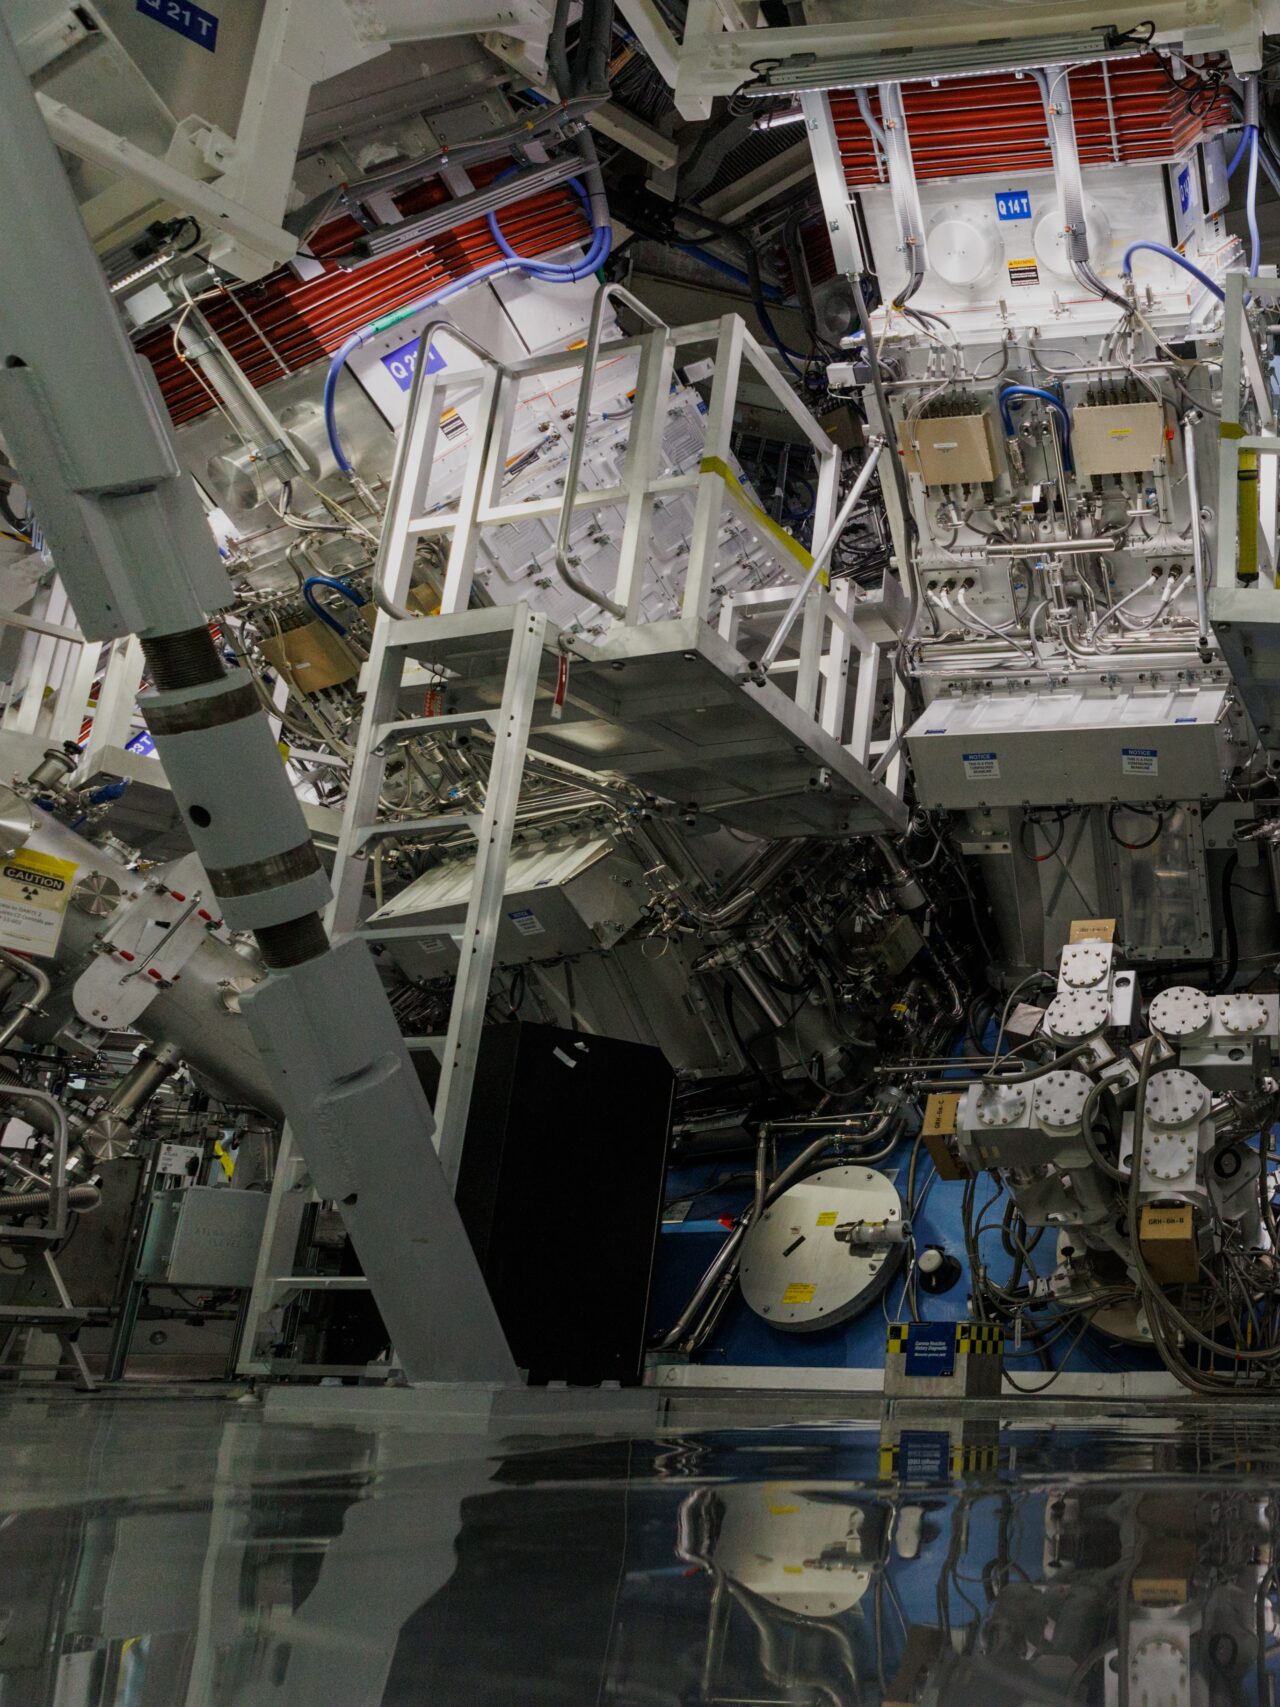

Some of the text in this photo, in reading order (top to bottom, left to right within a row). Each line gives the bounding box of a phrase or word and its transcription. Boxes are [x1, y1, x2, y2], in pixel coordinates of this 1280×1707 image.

[166, 2, 191, 26] 21
[197, 17, 213, 36] T
[998, 198, 1028, 216] Q 14 T
[390, 361, 408, 379] Q
[139, 735, 151, 745] T
[7, 868, 62, 890] CAUTION
